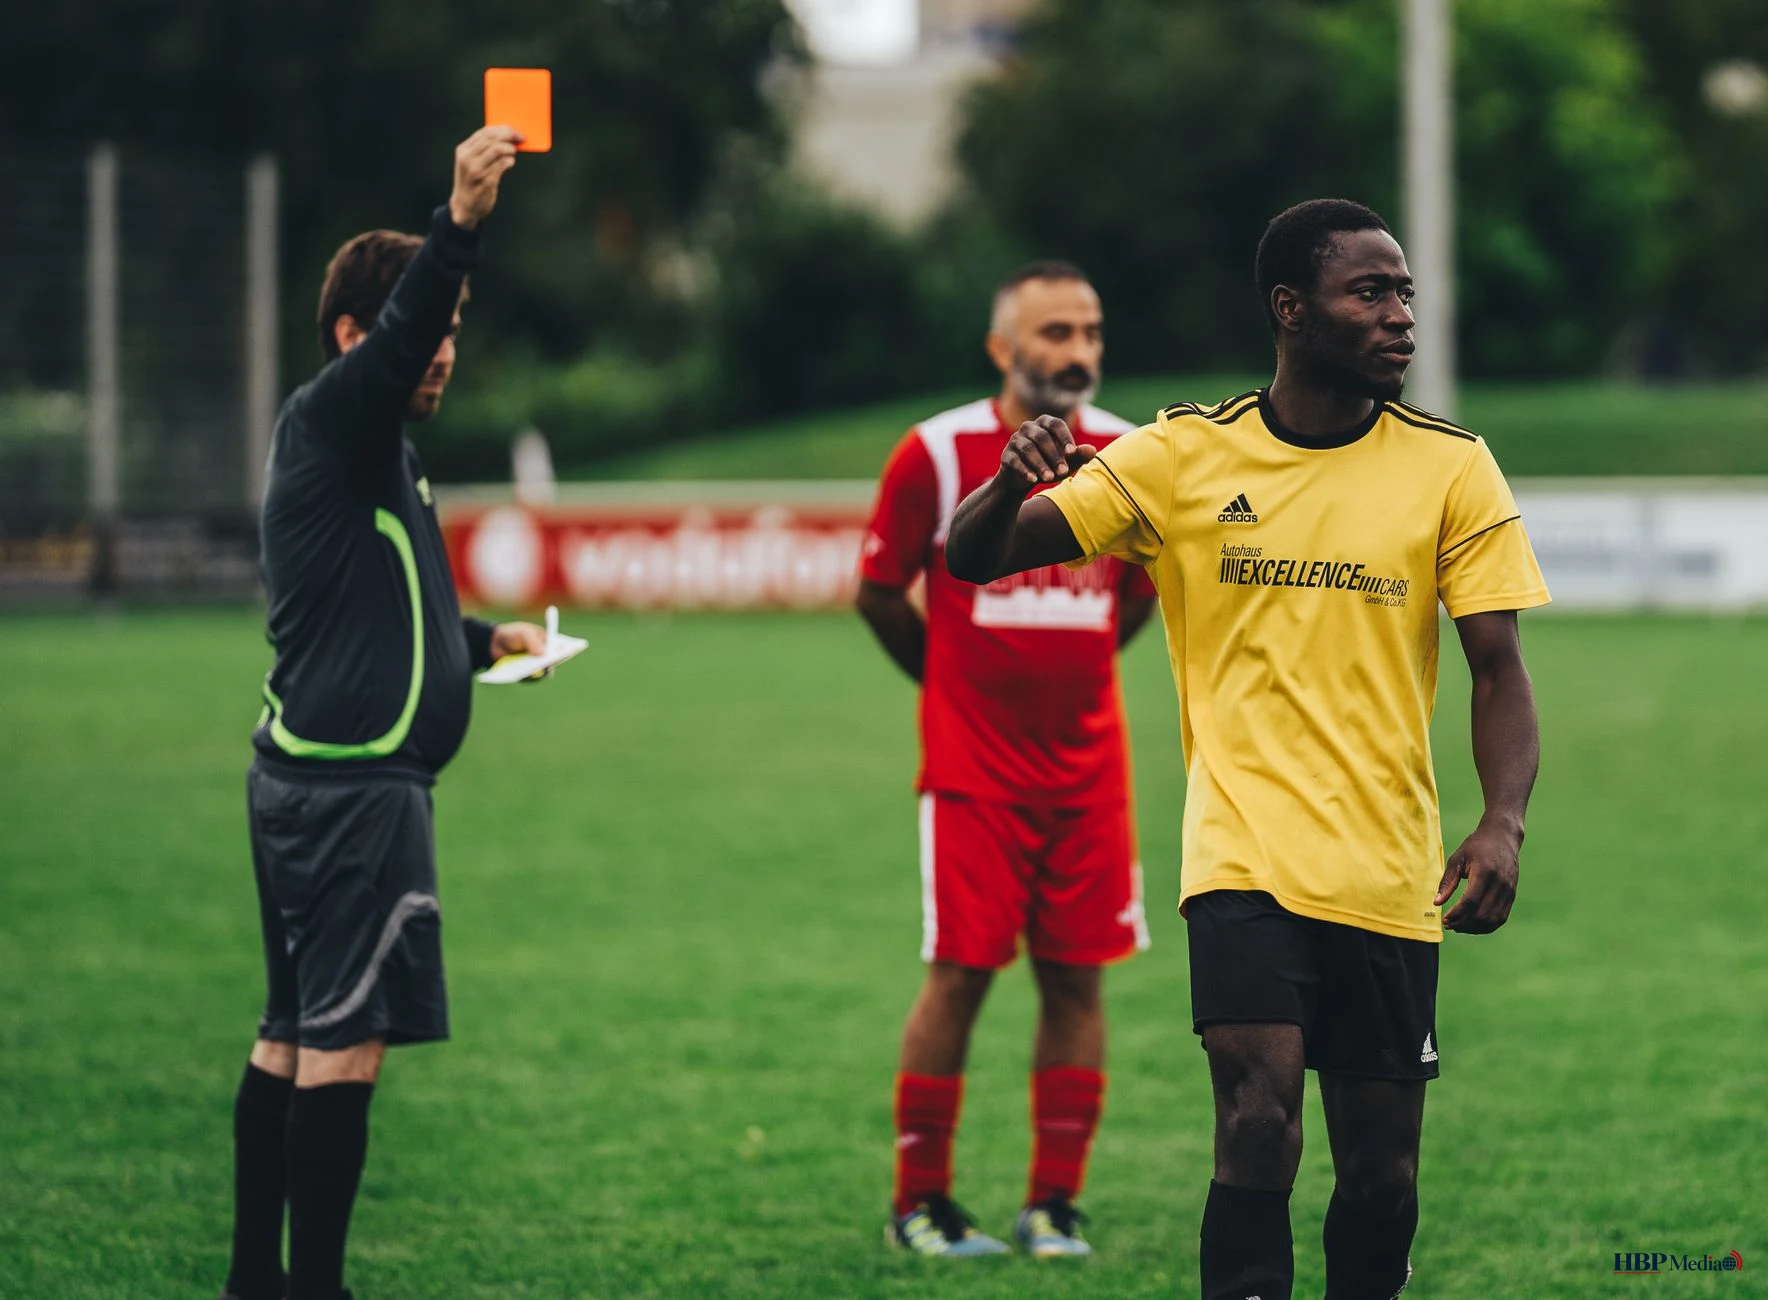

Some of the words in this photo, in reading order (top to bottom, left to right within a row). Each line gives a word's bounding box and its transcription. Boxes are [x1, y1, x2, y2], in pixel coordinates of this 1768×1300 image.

[1218, 511, 1258, 523] adidas
[1220, 543, 1262, 557] Autohaus
[1238, 559, 1365, 590] EXCELLENCE
[1380, 578, 1409, 596] CARS
[1365, 595, 1384, 605] GmbH
